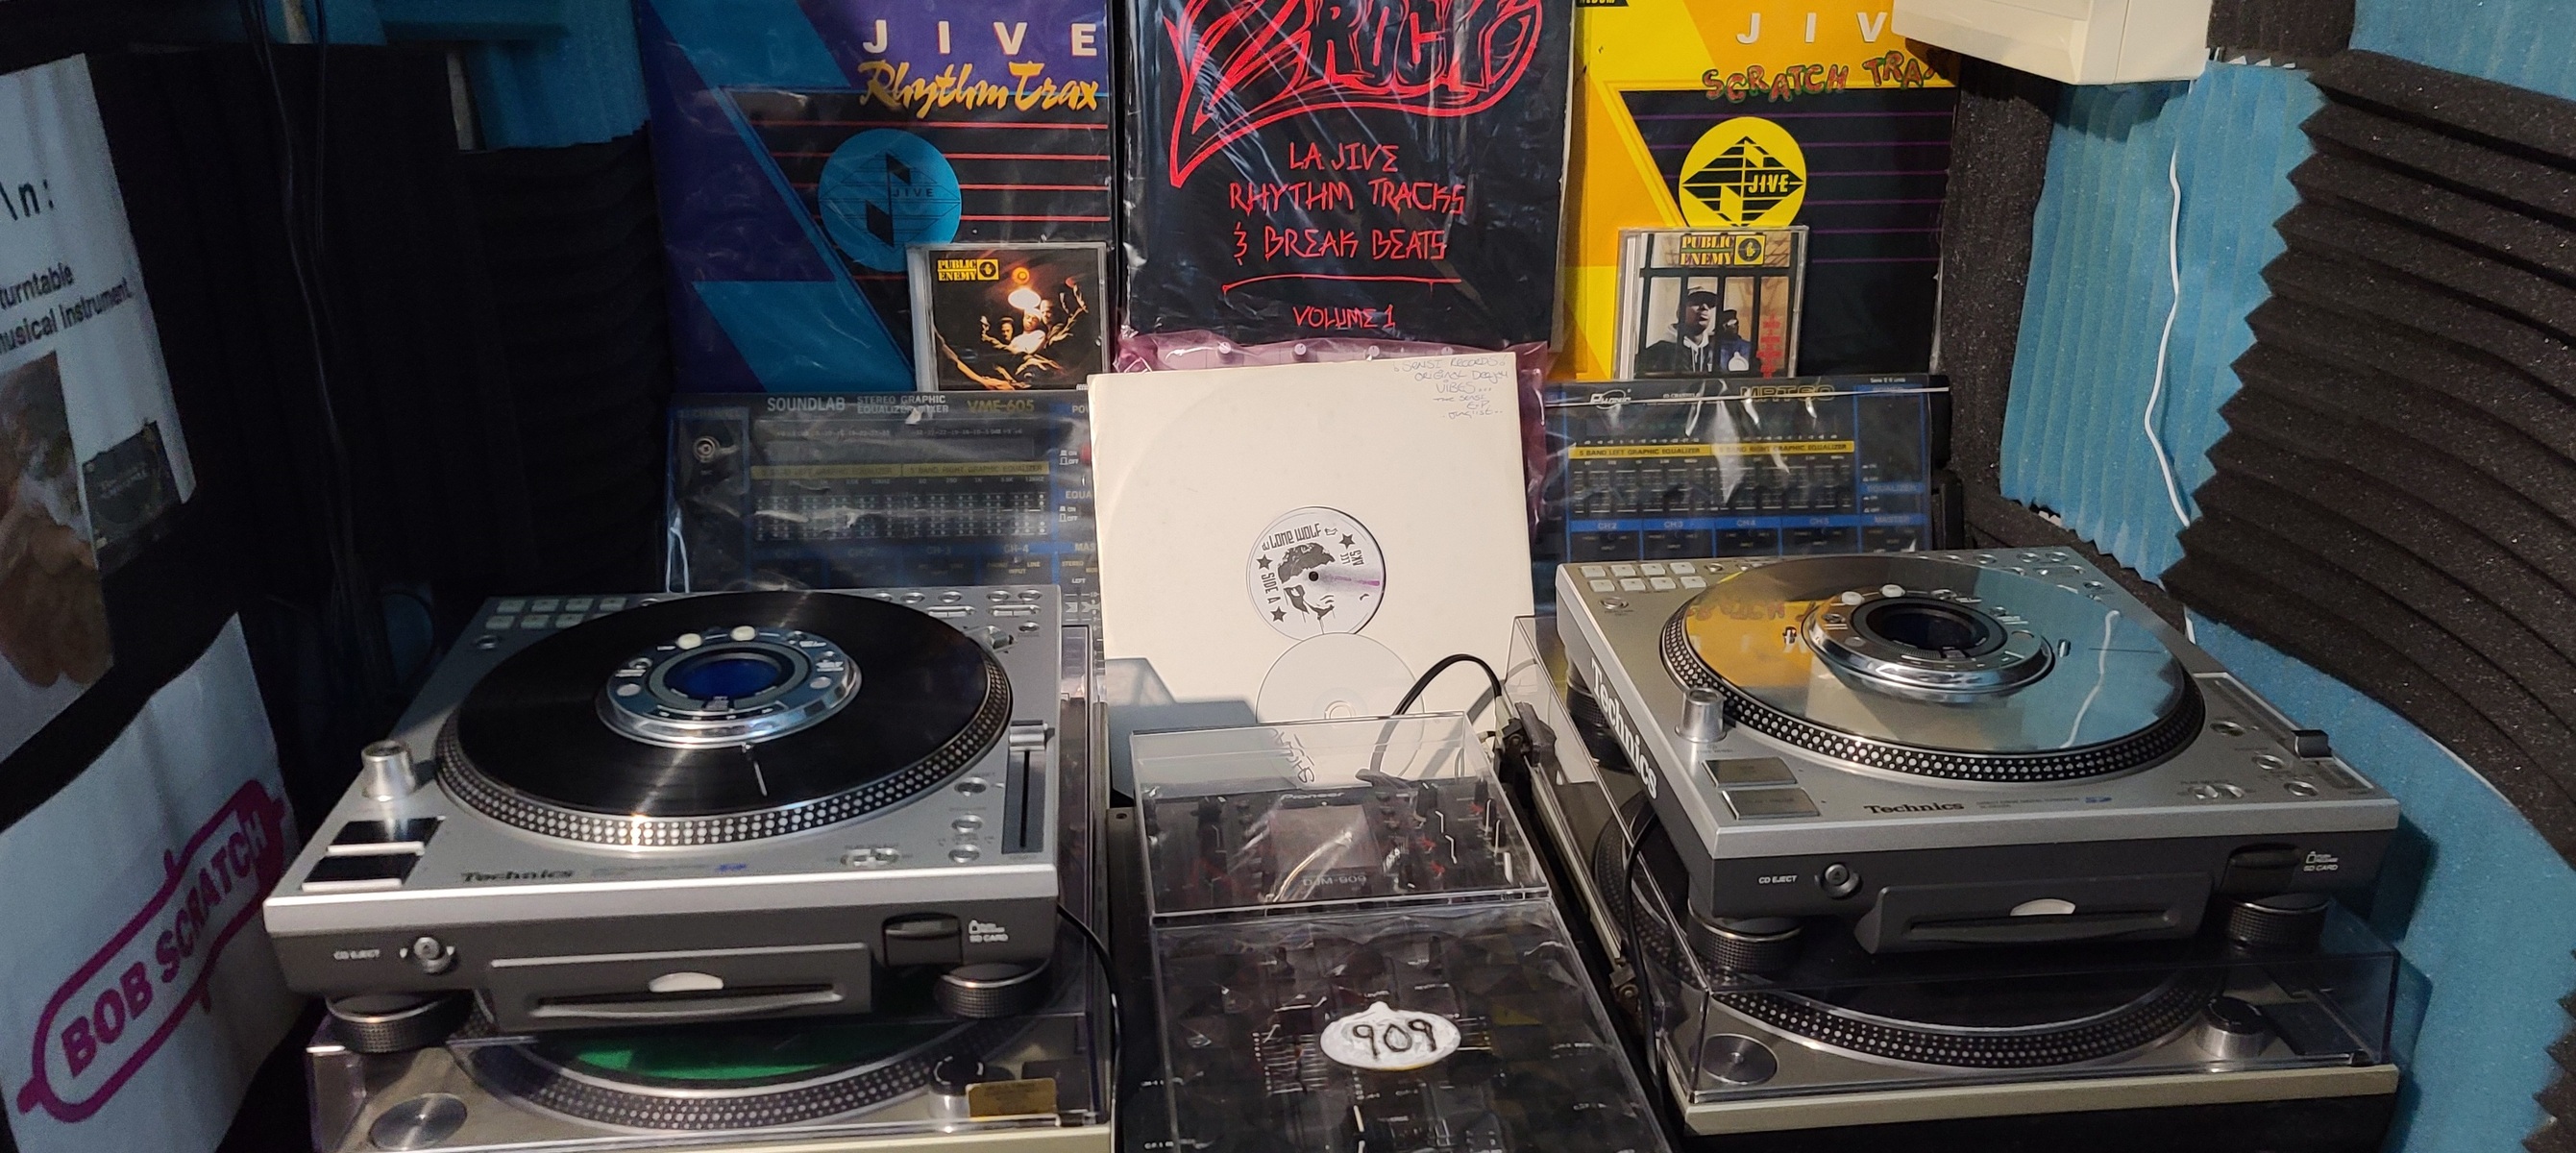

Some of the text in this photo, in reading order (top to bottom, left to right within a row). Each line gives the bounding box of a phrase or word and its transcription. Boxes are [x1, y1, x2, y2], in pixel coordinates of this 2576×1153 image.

[863, 19, 1097, 56] JIVE
[858, 60, 1099, 119] Rhythm Trax
[1702, 64, 1850, 103] SCRATCH
[1288, 142, 1399, 173] LA JIVE
[893, 187, 934, 199] JIVE
[1748, 174, 1789, 193] JIVE
[1229, 177, 1466, 218] RHYTHM TRACKS
[1264, 229, 1358, 260] BREAK
[1372, 228, 1447, 260] BEATS
[1681, 235, 1735, 248] PUBLIC
[937, 259, 976, 269] PUBLIC
[1681, 252, 1733, 265] ENEMY
[938, 271, 976, 281] ENEMY
[1293, 304, 1396, 329] VOLUME 1
[768, 397, 846, 411] SOUNDLAB
[900, 395, 946, 404] GRAPHIC
[1294, 523, 1321, 542] WOLF
[1261, 573, 1279, 594] SIDE
[1591, 657, 1657, 799] Technics
[1863, 802, 1965, 814] Technics
[1772, 874, 1798, 884] EJECT
[61, 810, 269, 1079] BOB SCRATCH
[1353, 1018, 1436, 1060] 909
